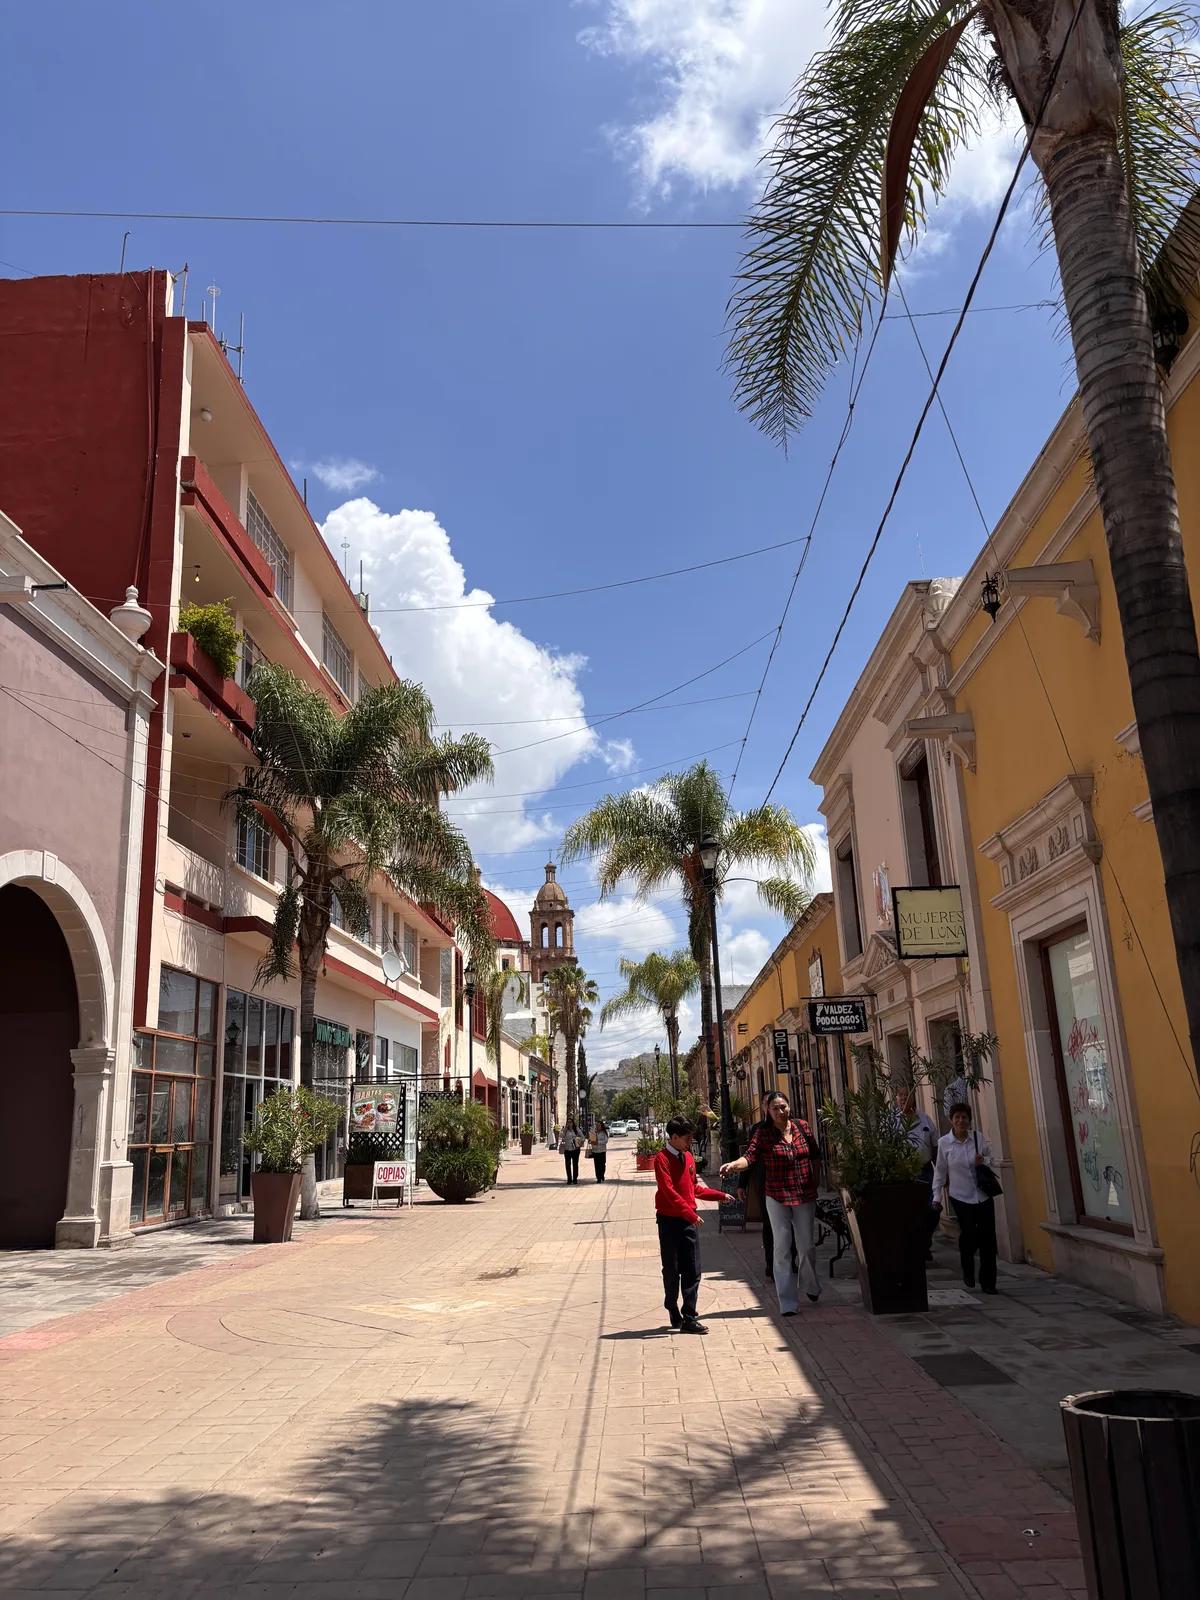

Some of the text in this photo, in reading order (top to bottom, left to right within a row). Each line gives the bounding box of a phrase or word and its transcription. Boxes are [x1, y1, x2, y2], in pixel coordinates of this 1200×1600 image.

[900, 911, 964, 924] MUJERES
[902, 925, 965, 940] DE LUNA
[824, 1004, 853, 1015] VALDEZ
[816, 1015, 860, 1026] PODOLOGOS
[775, 1031, 789, 1071] OPTICA
[377, 1166, 405, 1180] COPIAS
